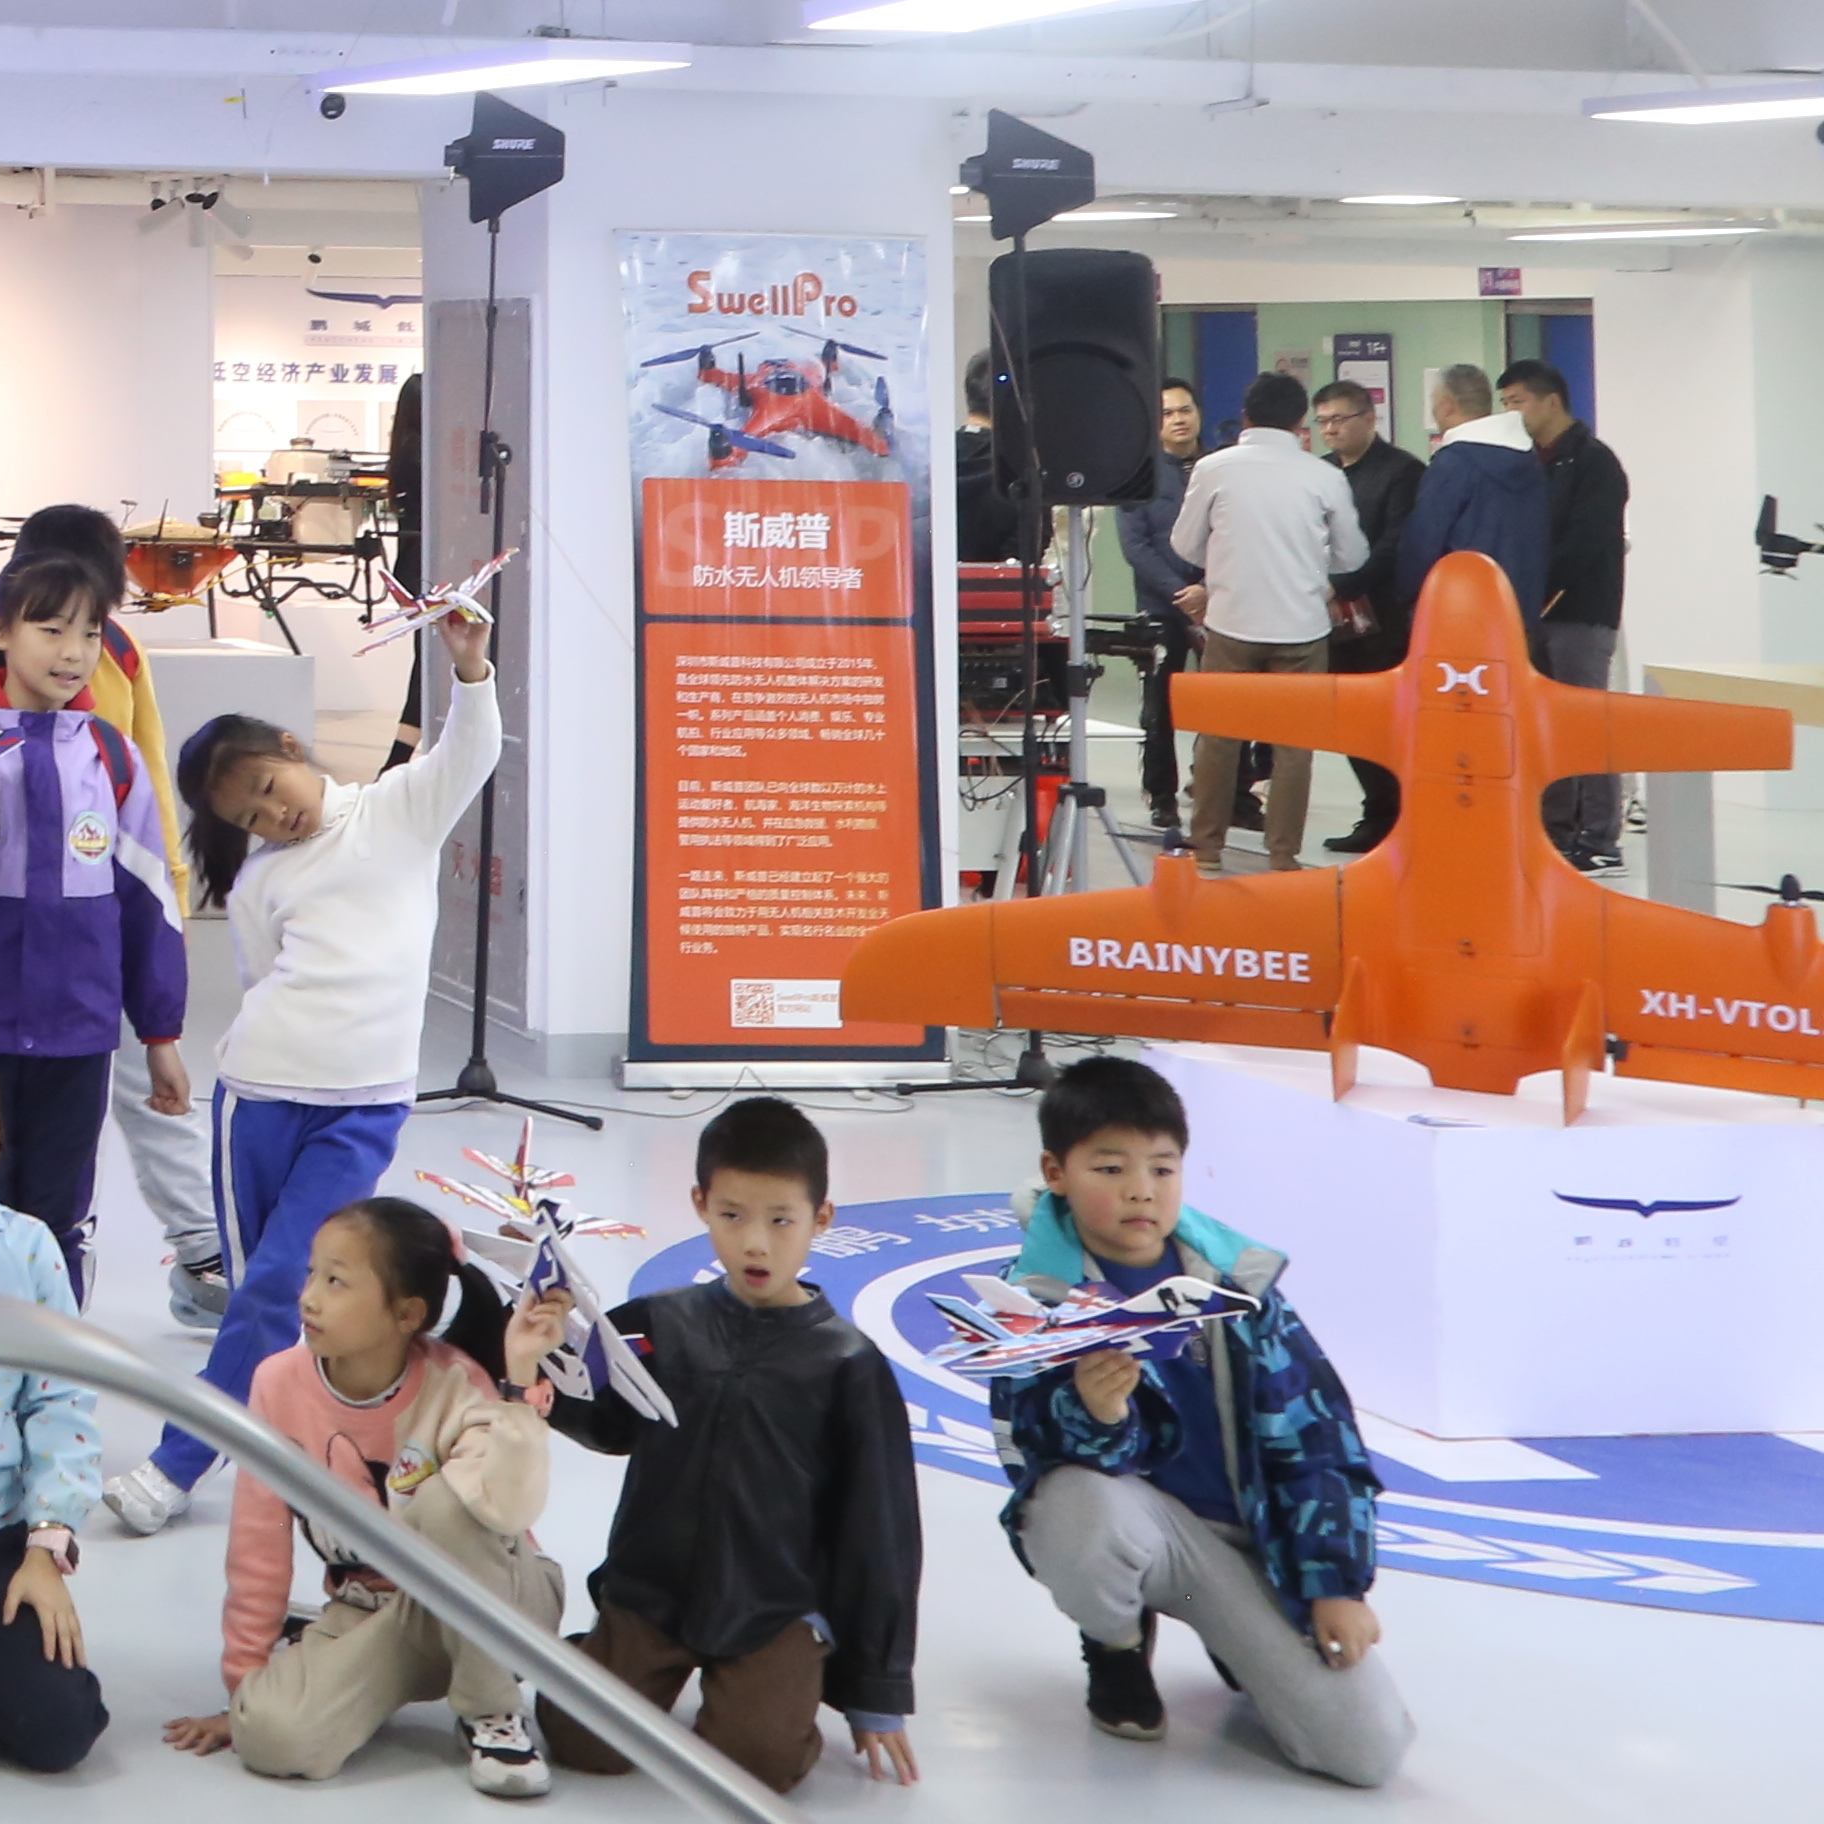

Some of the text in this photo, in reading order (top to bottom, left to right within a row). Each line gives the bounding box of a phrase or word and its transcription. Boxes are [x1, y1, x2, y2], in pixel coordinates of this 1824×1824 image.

[492, 138, 537, 151] SHURE
[1012, 157, 1061, 171] SHURE
[687, 269, 859, 318] SwellPro
[723, 510, 831, 550] 斯威普
[692, 565, 865, 590] 防水无人机领导者
[1068, 937, 1311, 983] BRAINYBEE
[1639, 989, 1824, 1035] XH-VTOL
